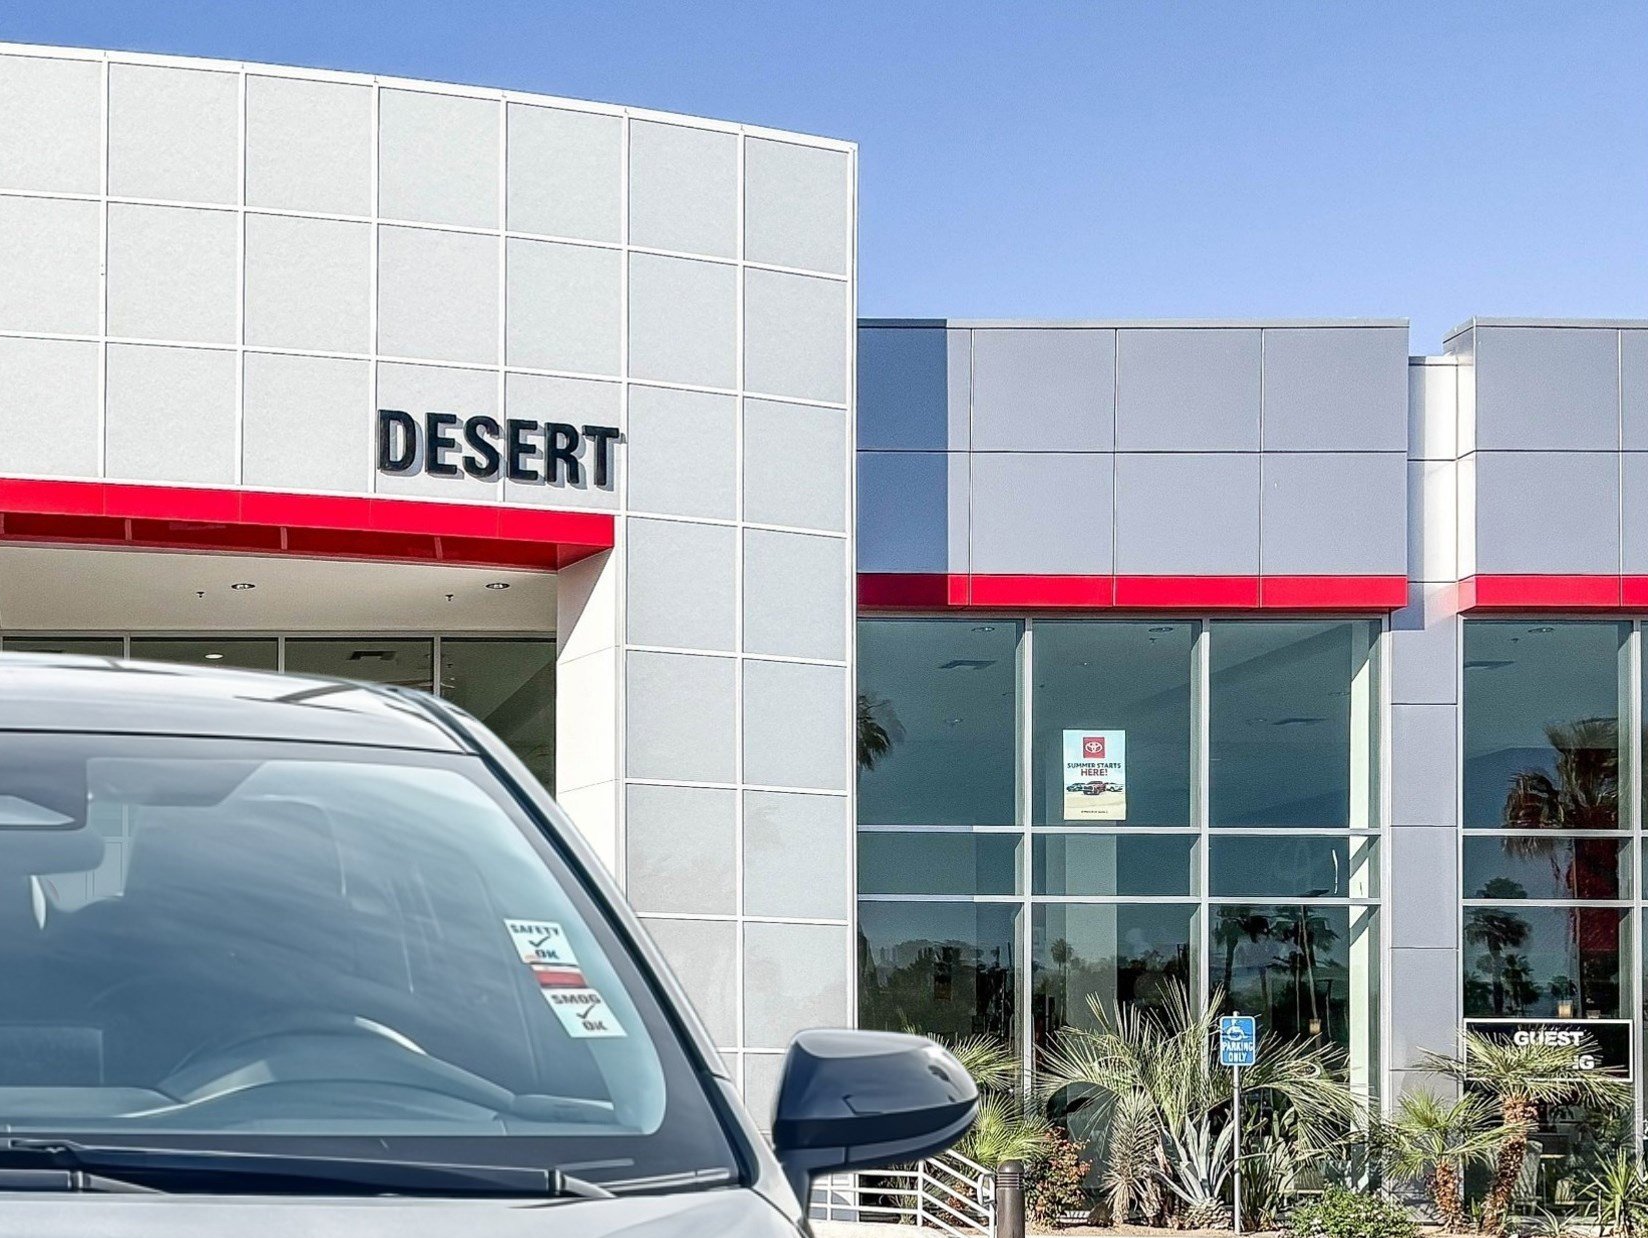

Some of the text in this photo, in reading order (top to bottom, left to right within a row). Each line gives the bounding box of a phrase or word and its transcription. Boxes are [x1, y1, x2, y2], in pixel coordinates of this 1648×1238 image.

[377, 409, 620, 487] DESERT
[1080, 768, 1108, 777] HERE!
[509, 923, 560, 936] SAFETY
[551, 993, 602, 1005] SMOG
[1513, 1030, 1584, 1047] GUEST
[1222, 1041, 1253, 1052] PARKING
[1228, 1051, 1248, 1063] ONLY
